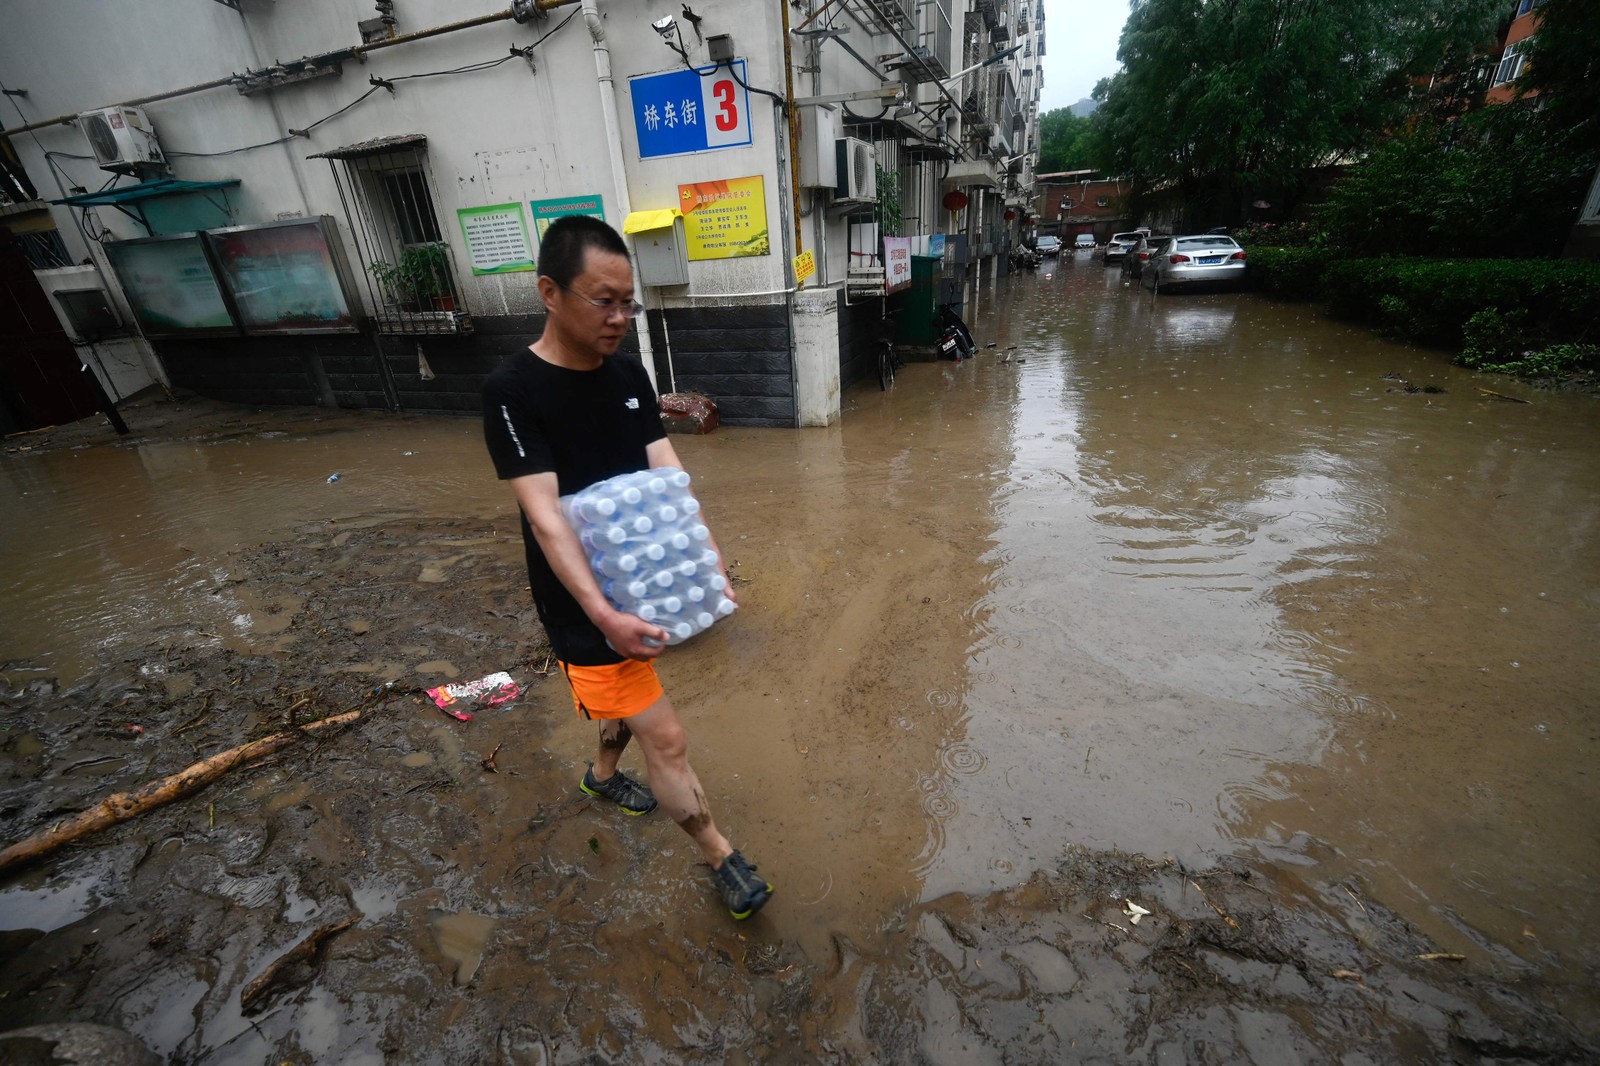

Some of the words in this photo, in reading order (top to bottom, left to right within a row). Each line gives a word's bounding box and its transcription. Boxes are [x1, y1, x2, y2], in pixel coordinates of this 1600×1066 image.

[644, 99, 697, 131] 桥东街
[713, 79, 738, 132] 3
